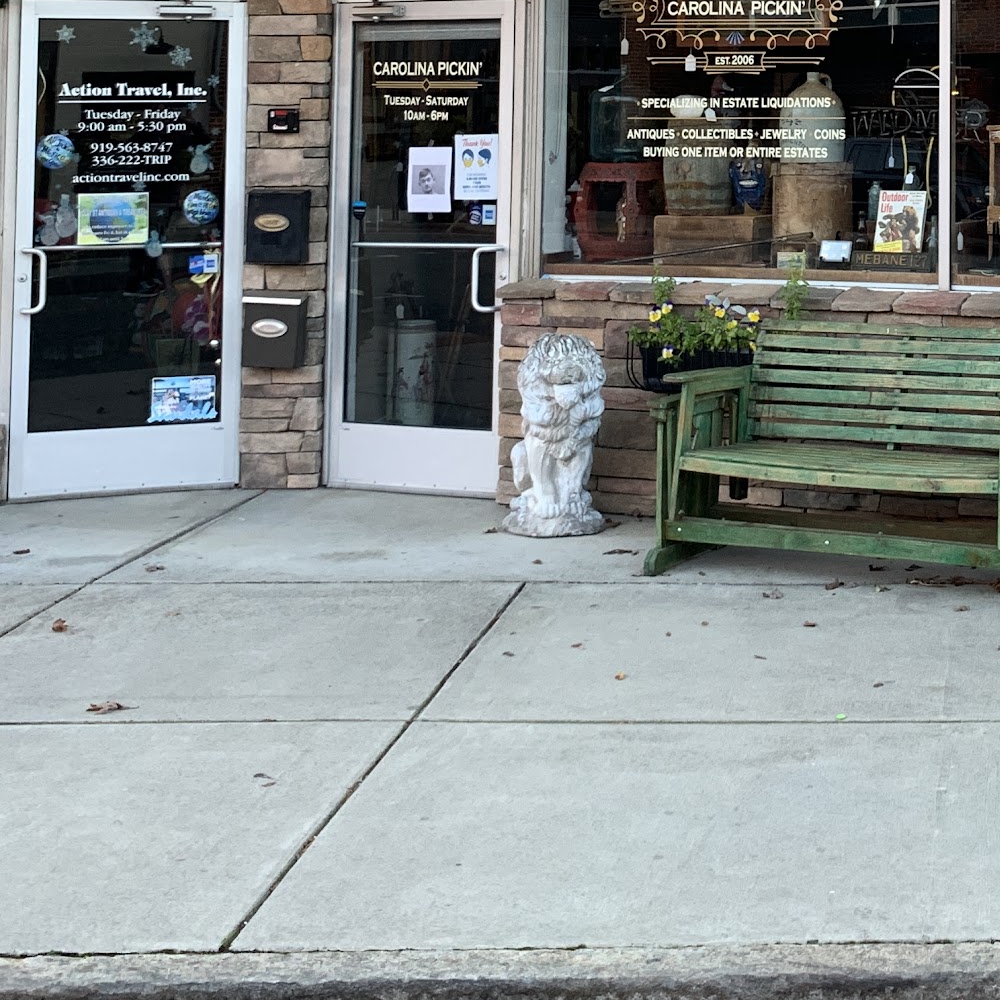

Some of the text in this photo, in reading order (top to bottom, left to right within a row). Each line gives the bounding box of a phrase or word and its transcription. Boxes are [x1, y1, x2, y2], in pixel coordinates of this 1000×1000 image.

[667, 0, 806, 16] CAROLINA PICKIN'
[373, 61, 483, 76] CAROLINA PICKIN'
[58, 82, 207, 98] Action Travel, Inc.
[641, 97, 831, 109] SPECIALIZING IN ESTATE LIQUIDATIONS
[84, 109, 134, 122] Tuesday
[144, 109, 182, 122] Friday
[77, 122, 105, 133] 9:00
[108, 124, 127, 132] am
[136, 122, 164, 132] 5:30
[166, 124, 187, 134] pm
[627, 128, 846, 141] ANTIQUES COLLECTIBLES JEWELRY COINS
[90, 143, 173, 154] 919-563-8747
[643, 146, 828, 158] BUYING ONE ITEM OR ENTIRE ESTATES
[91, 154, 173, 167] 336-222-TRIP
[72, 172, 190, 183] actiontravelinc.com
[881, 191, 909, 202] Outdoor
[880, 203, 894, 213] Life
[855, 253, 907, 266] MEBANE
